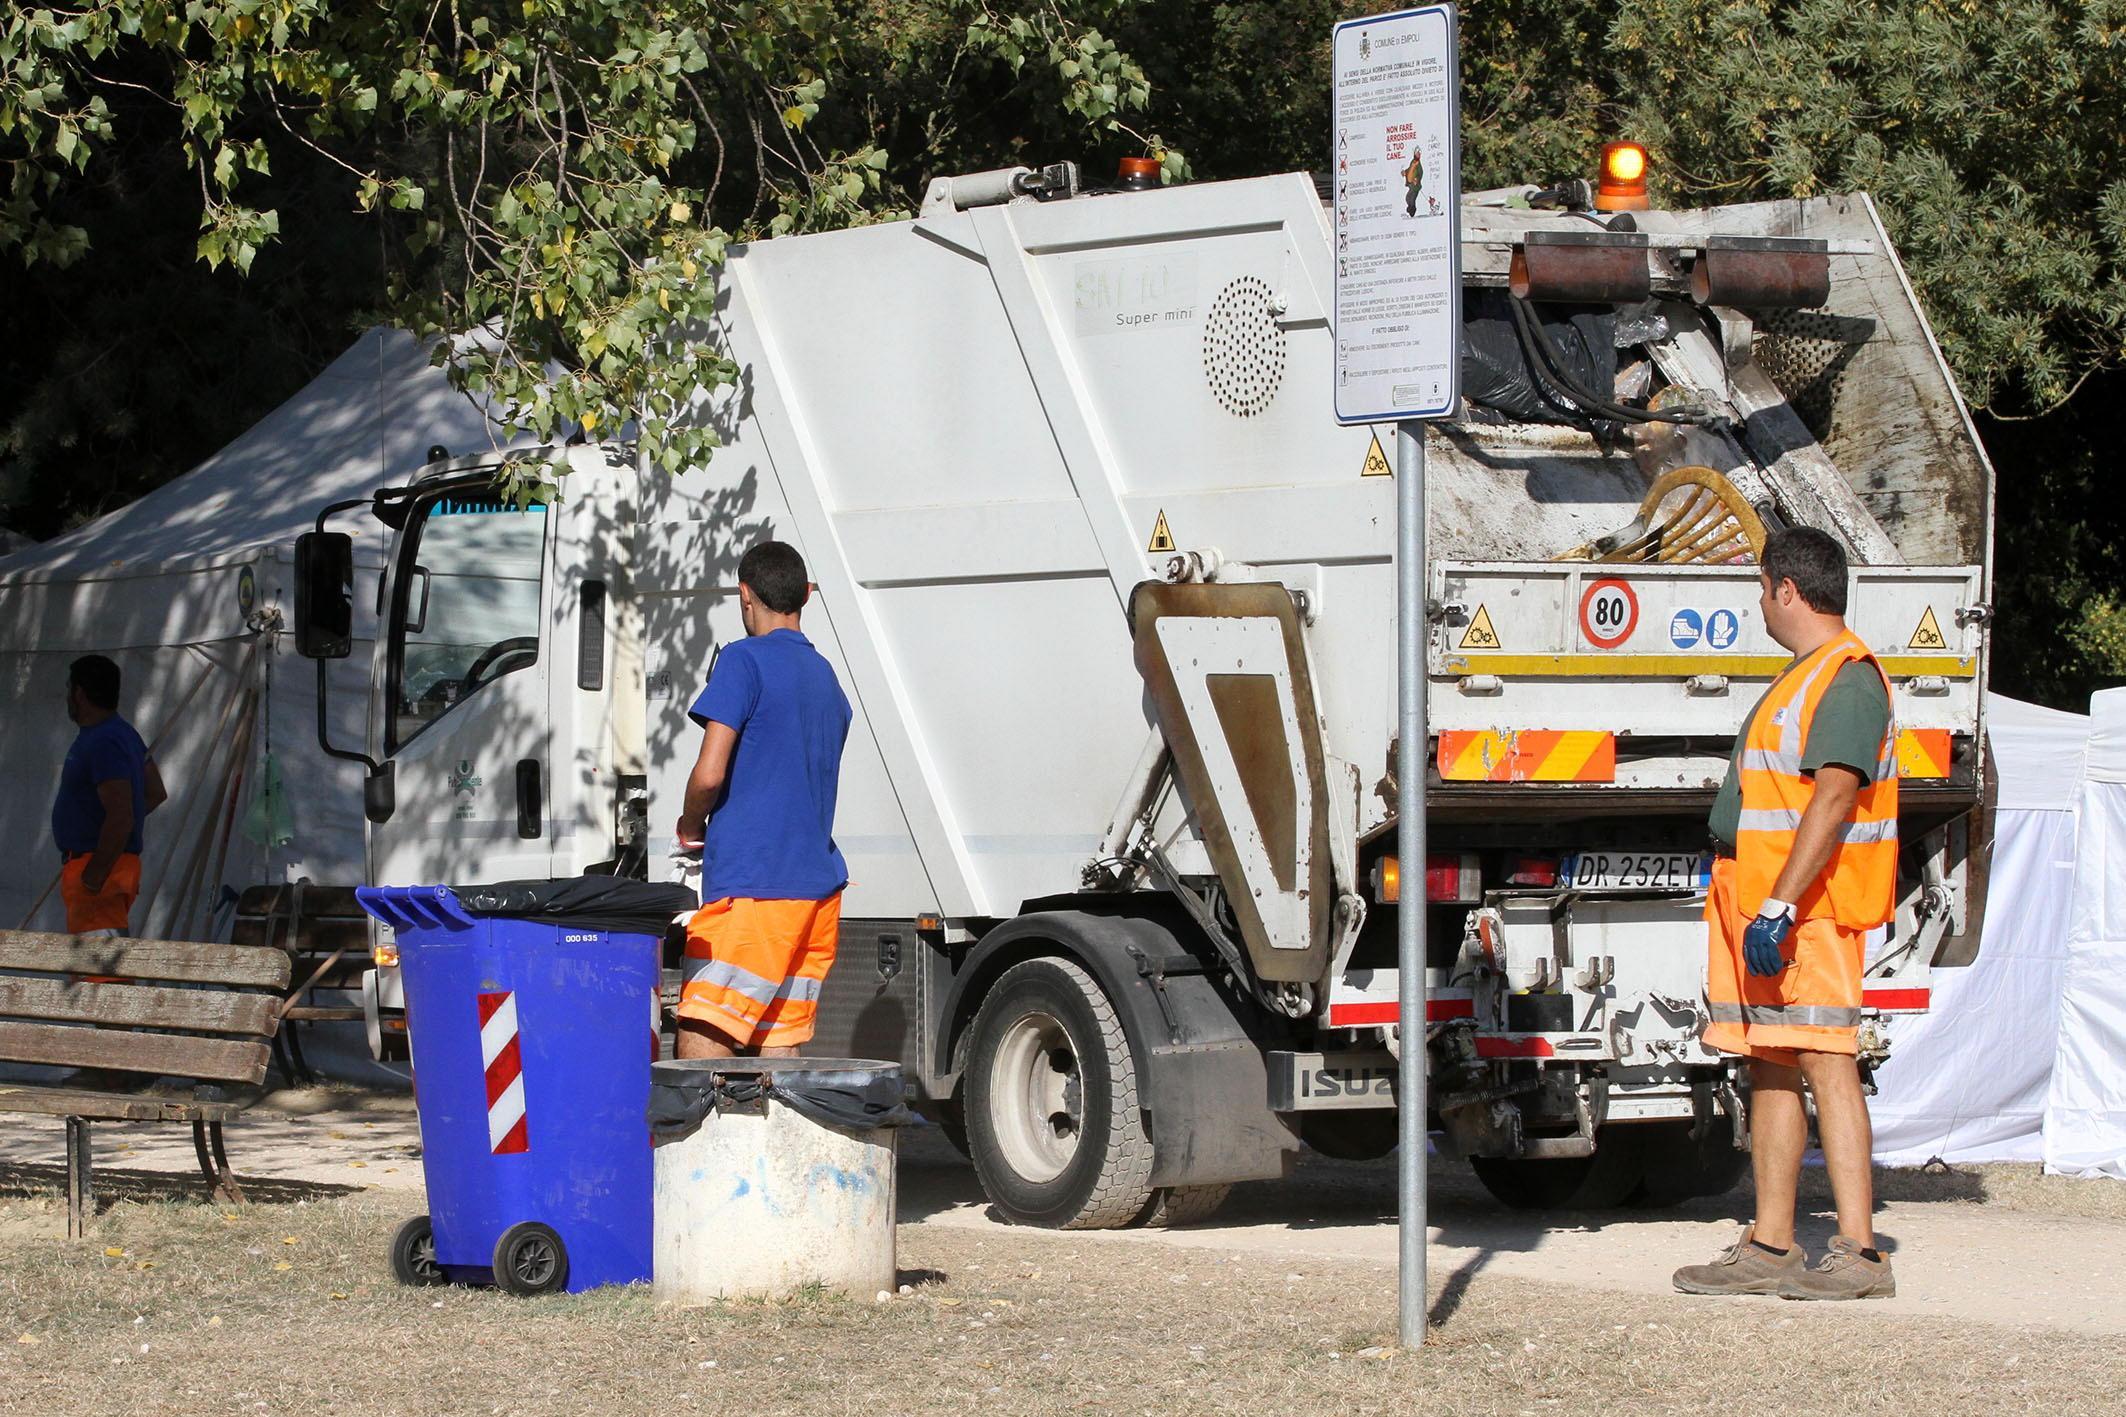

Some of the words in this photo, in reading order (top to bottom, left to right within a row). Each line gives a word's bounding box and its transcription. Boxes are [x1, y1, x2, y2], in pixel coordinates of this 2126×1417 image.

[1375, 37, 1395, 48] COMUNE
[1401, 33, 1420, 44] EMPOLI
[1401, 68, 1420, 78] ASSOLUTO
[1386, 125, 1398, 134] NON
[1399, 123, 1412, 132] FARE
[1386, 131, 1416, 143] ARROSSIRE
[1393, 142, 1404, 151] TUO
[1116, 311, 1158, 327] Super
[1164, 308, 1192, 321] mini
[1595, 597, 1624, 626] 80
[1577, 855, 1610, 886] DR
[1618, 855, 1698, 886] 252EY
[566, 934, 581, 943] 000
